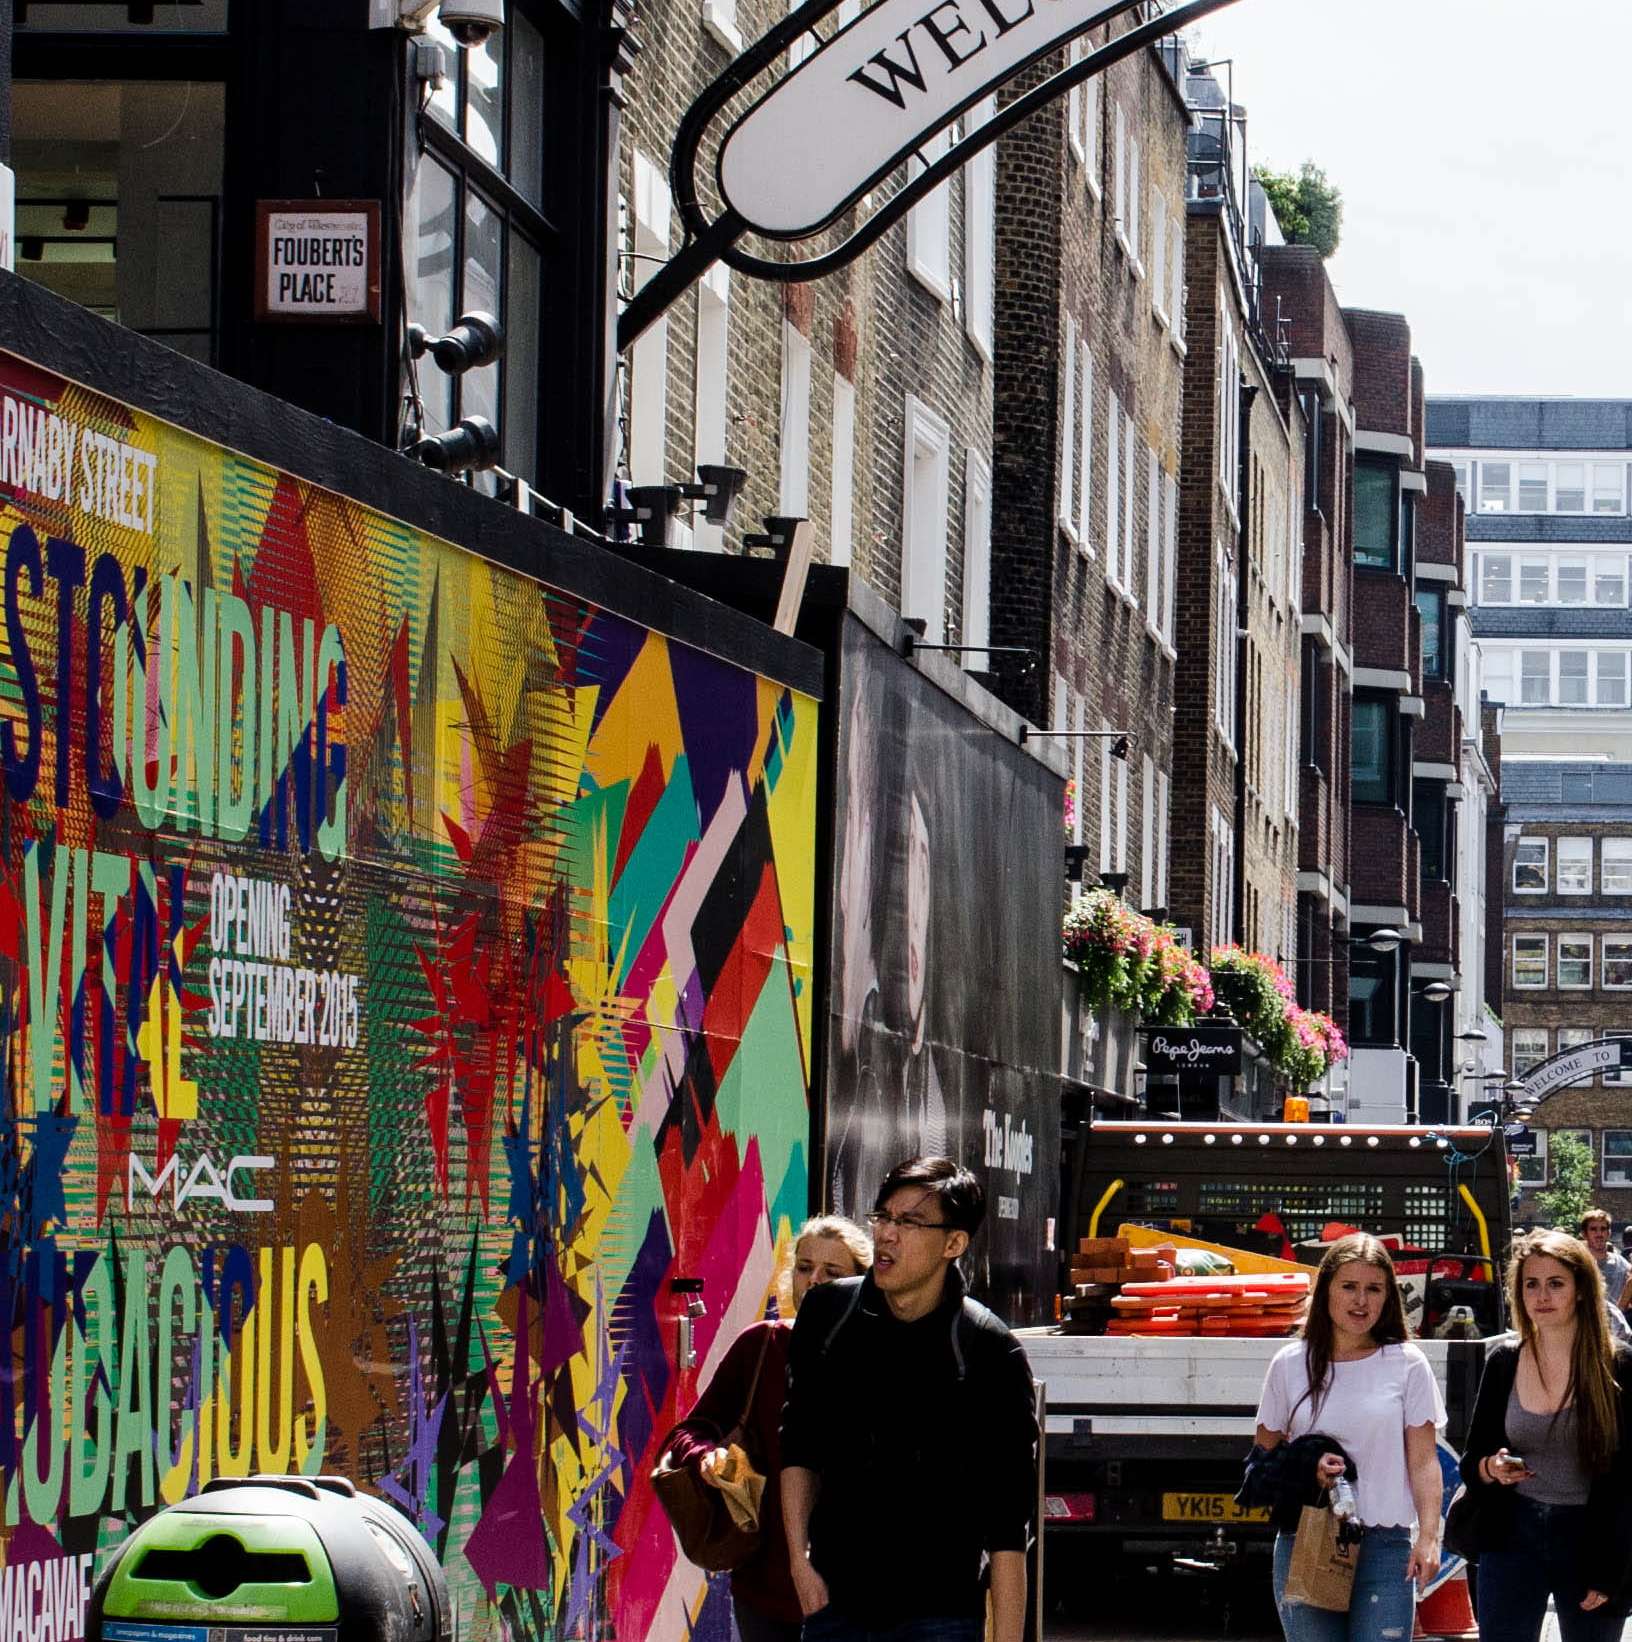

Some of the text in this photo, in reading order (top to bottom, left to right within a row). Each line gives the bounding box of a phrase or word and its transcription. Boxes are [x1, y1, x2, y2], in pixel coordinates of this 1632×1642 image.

[273, 234, 364, 267] FOUBERT'S
[279, 273, 336, 304] PLACE
[0, 394, 158, 534] RNABY STREET
[210, 872, 291, 960] OPENING
[24, 838, 198, 1120] VITAL
[208, 957, 358, 1049] SEPTEMBER 2015
[1152, 1037, 1235, 1062] Pepe Jeans
[1524, 1058, 1583, 1097] WELCOME
[1594, 1051, 1610, 1063] TO
[1177, 1497, 1225, 1518] YK15
